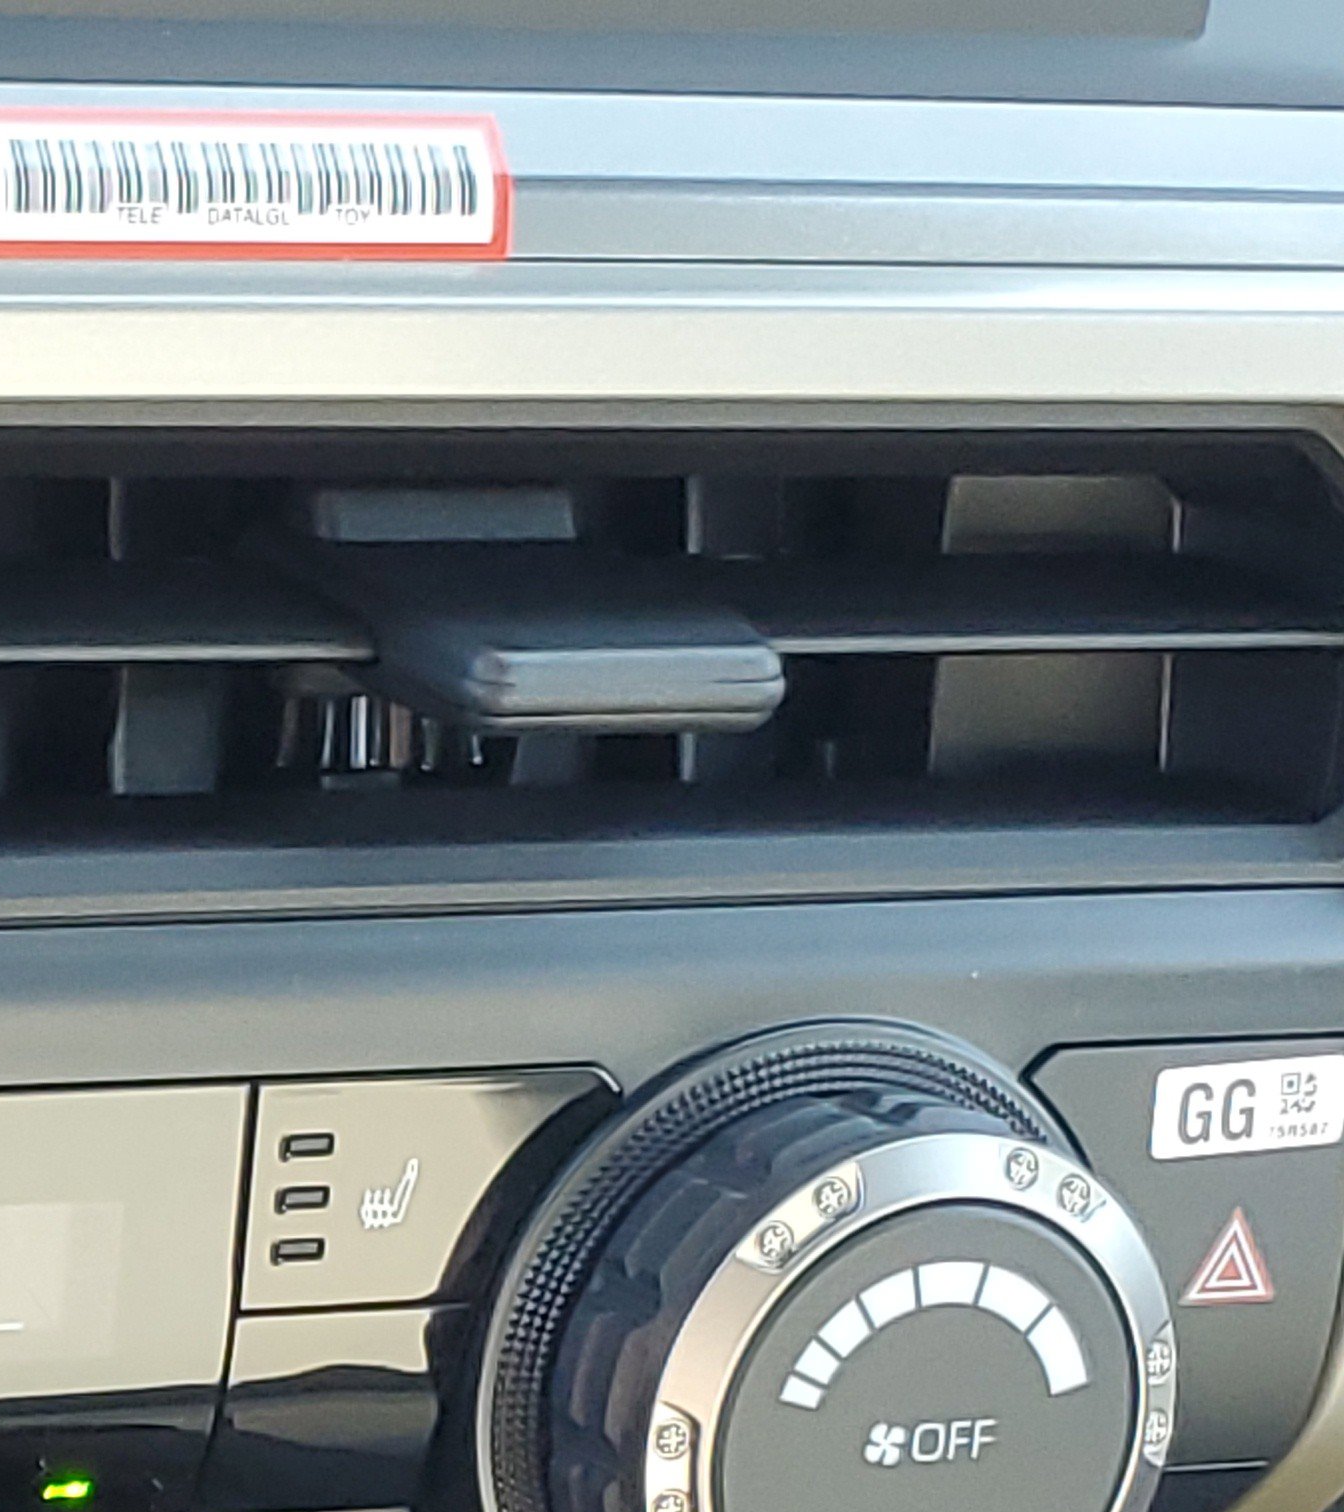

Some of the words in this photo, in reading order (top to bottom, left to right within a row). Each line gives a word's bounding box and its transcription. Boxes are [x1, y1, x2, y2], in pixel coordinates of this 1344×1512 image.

[116, 206, 163, 225] TELE
[1177, 1078, 1257, 1145] GG
[912, 1418, 999, 1463] OFF
